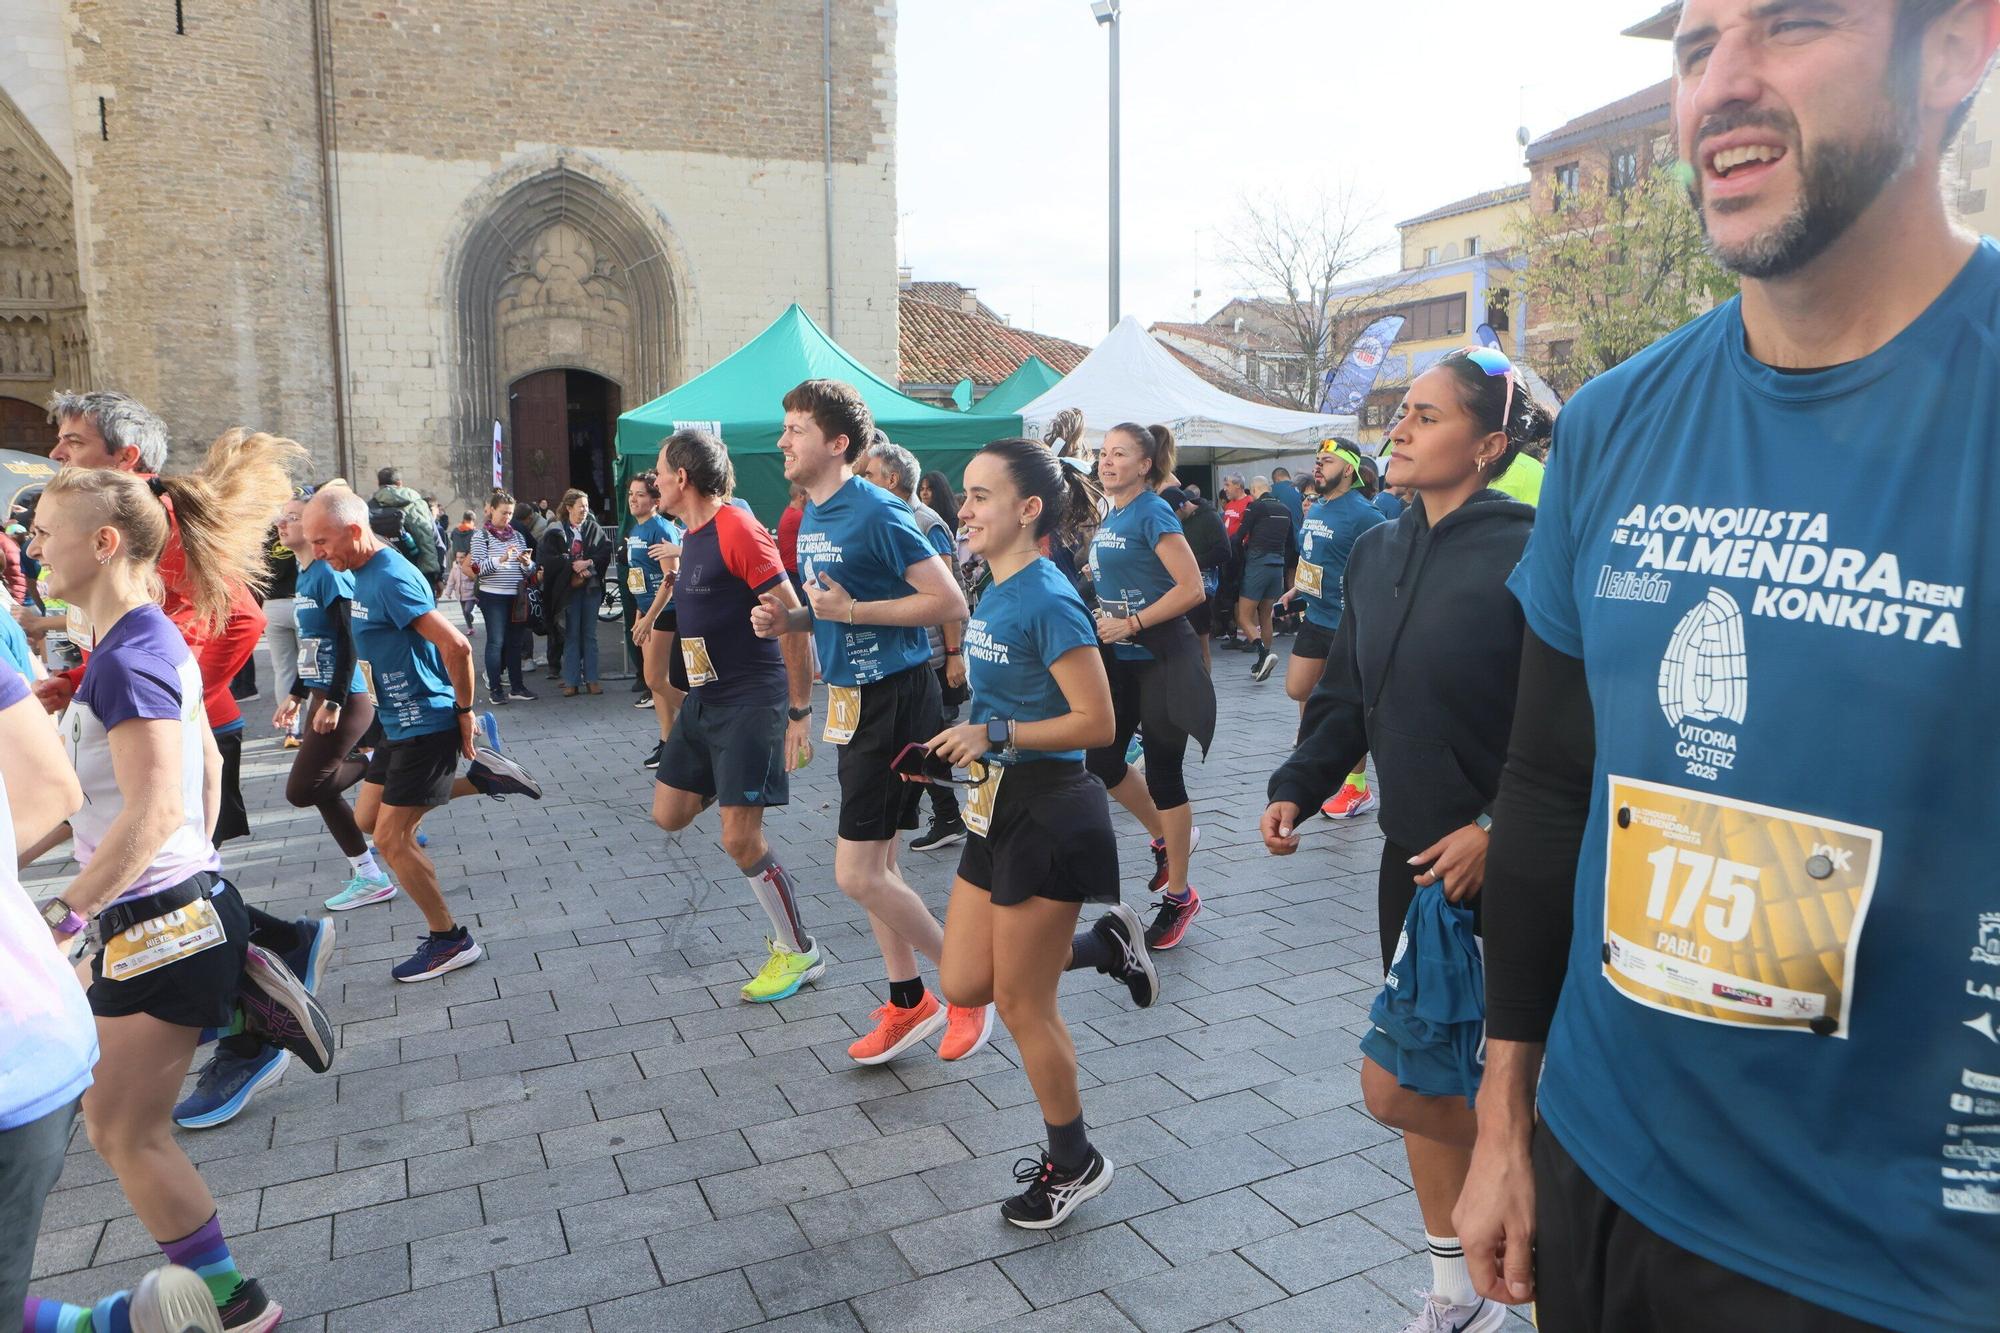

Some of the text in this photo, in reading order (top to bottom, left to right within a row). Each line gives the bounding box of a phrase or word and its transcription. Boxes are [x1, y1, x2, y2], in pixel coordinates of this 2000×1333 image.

[1648, 504, 1828, 542] CONQUISTA
[1636, 532, 1902, 598] ALMENDRA
[1904, 580, 1965, 608] REN
[1605, 570, 1672, 604] Edición
[1751, 585, 1962, 648] KONKISTA
[993, 643, 1008, 653] REN
[1679, 723, 1737, 752] VITORIA
[1675, 741, 1736, 770] GASTEIZ
[1685, 761, 1718, 781] 2025
[1646, 845, 1761, 942] 175
[1656, 932, 1712, 964] PABLO
